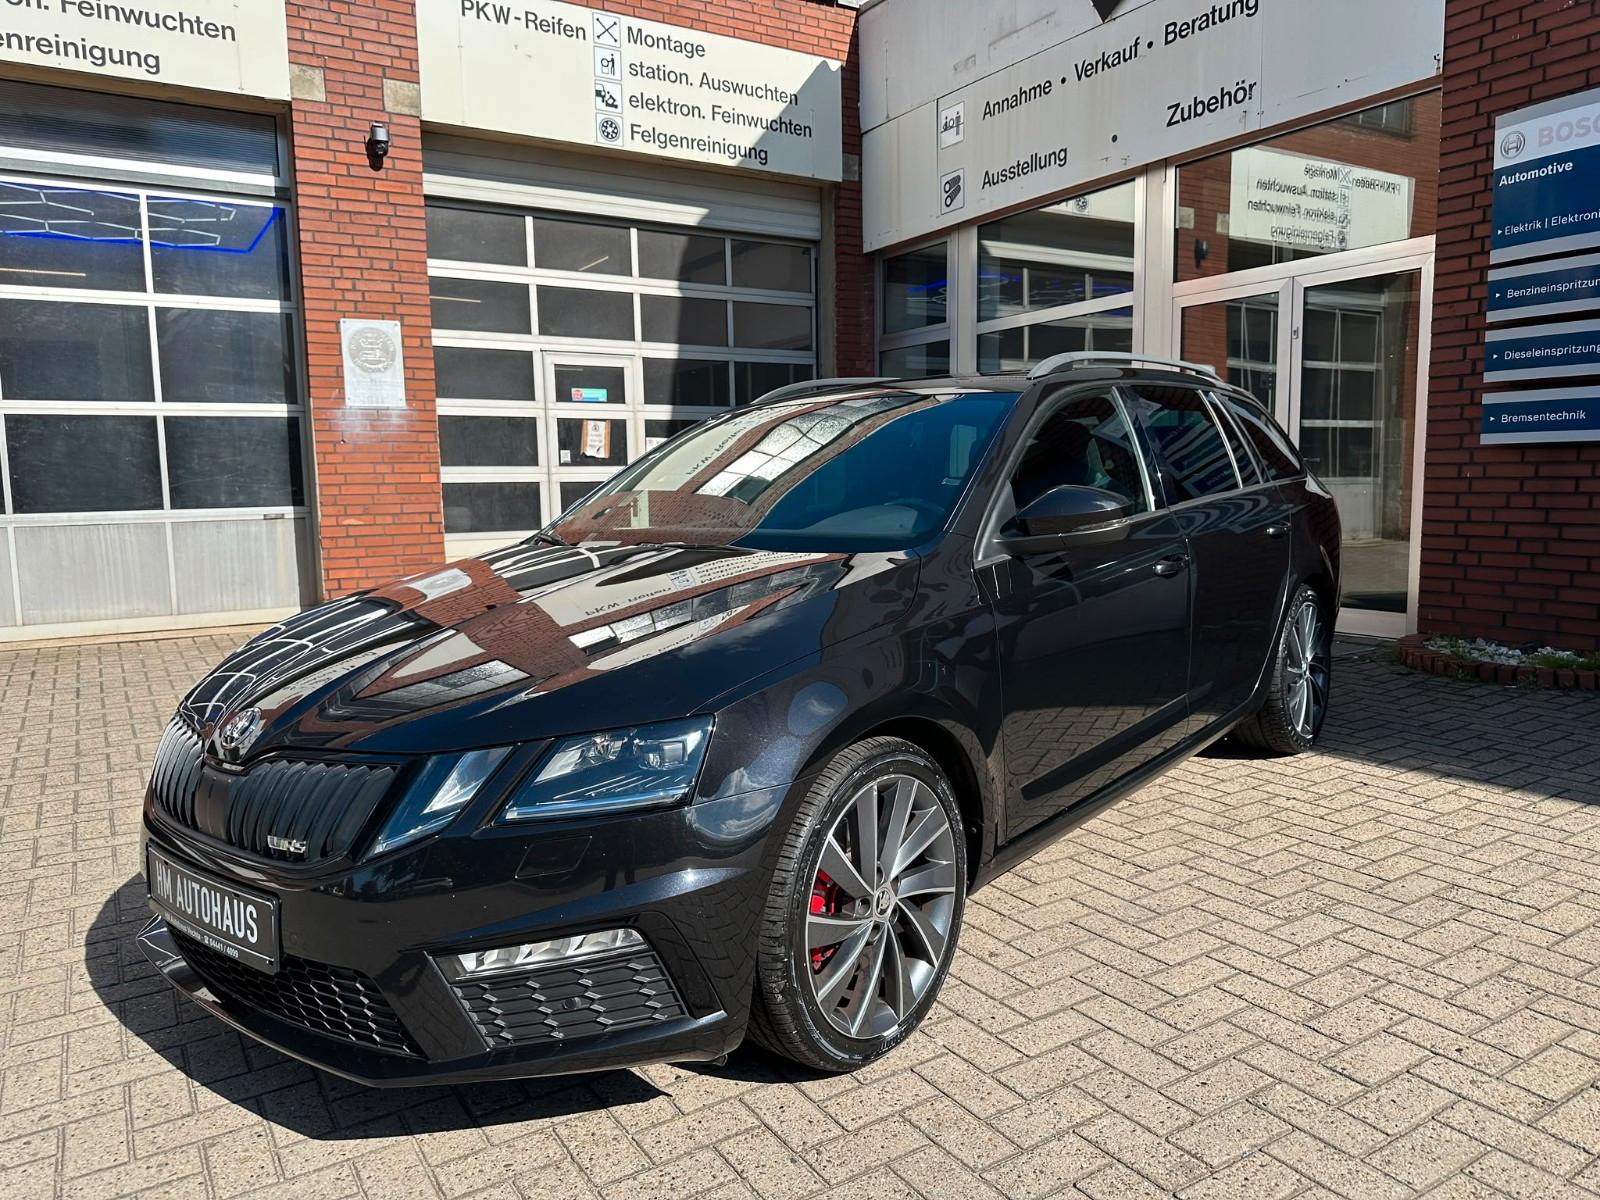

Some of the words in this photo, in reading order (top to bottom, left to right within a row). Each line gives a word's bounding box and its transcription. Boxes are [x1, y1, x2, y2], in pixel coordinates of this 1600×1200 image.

[61, 0, 236, 42] Feinwuchten
[627, 25, 706, 59] Montage
[0, 32, 161, 74] nreinigung
[982, 79, 1053, 121] Annahme
[1074, 37, 1141, 82] Verkauf
[1164, 0, 1259, 46] Beratung
[628, 61, 694, 87] station.
[699, 72, 798, 106] Auswuchten
[628, 92, 706, 120] elektron.
[711, 104, 812, 139] Feinwuchten
[981, 147, 1068, 190] Ausstellung
[1166, 80, 1257, 128] Zubehör
[629, 124, 768, 166] Felgenreinigung
[1499, 161, 1574, 187] Automotive
[1504, 219, 1542, 236] Elektrik
[1501, 410, 1587, 423] Bremsentechnik
[155, 860, 173, 903] HM
[176, 874, 259, 944] AUTOHAUS
